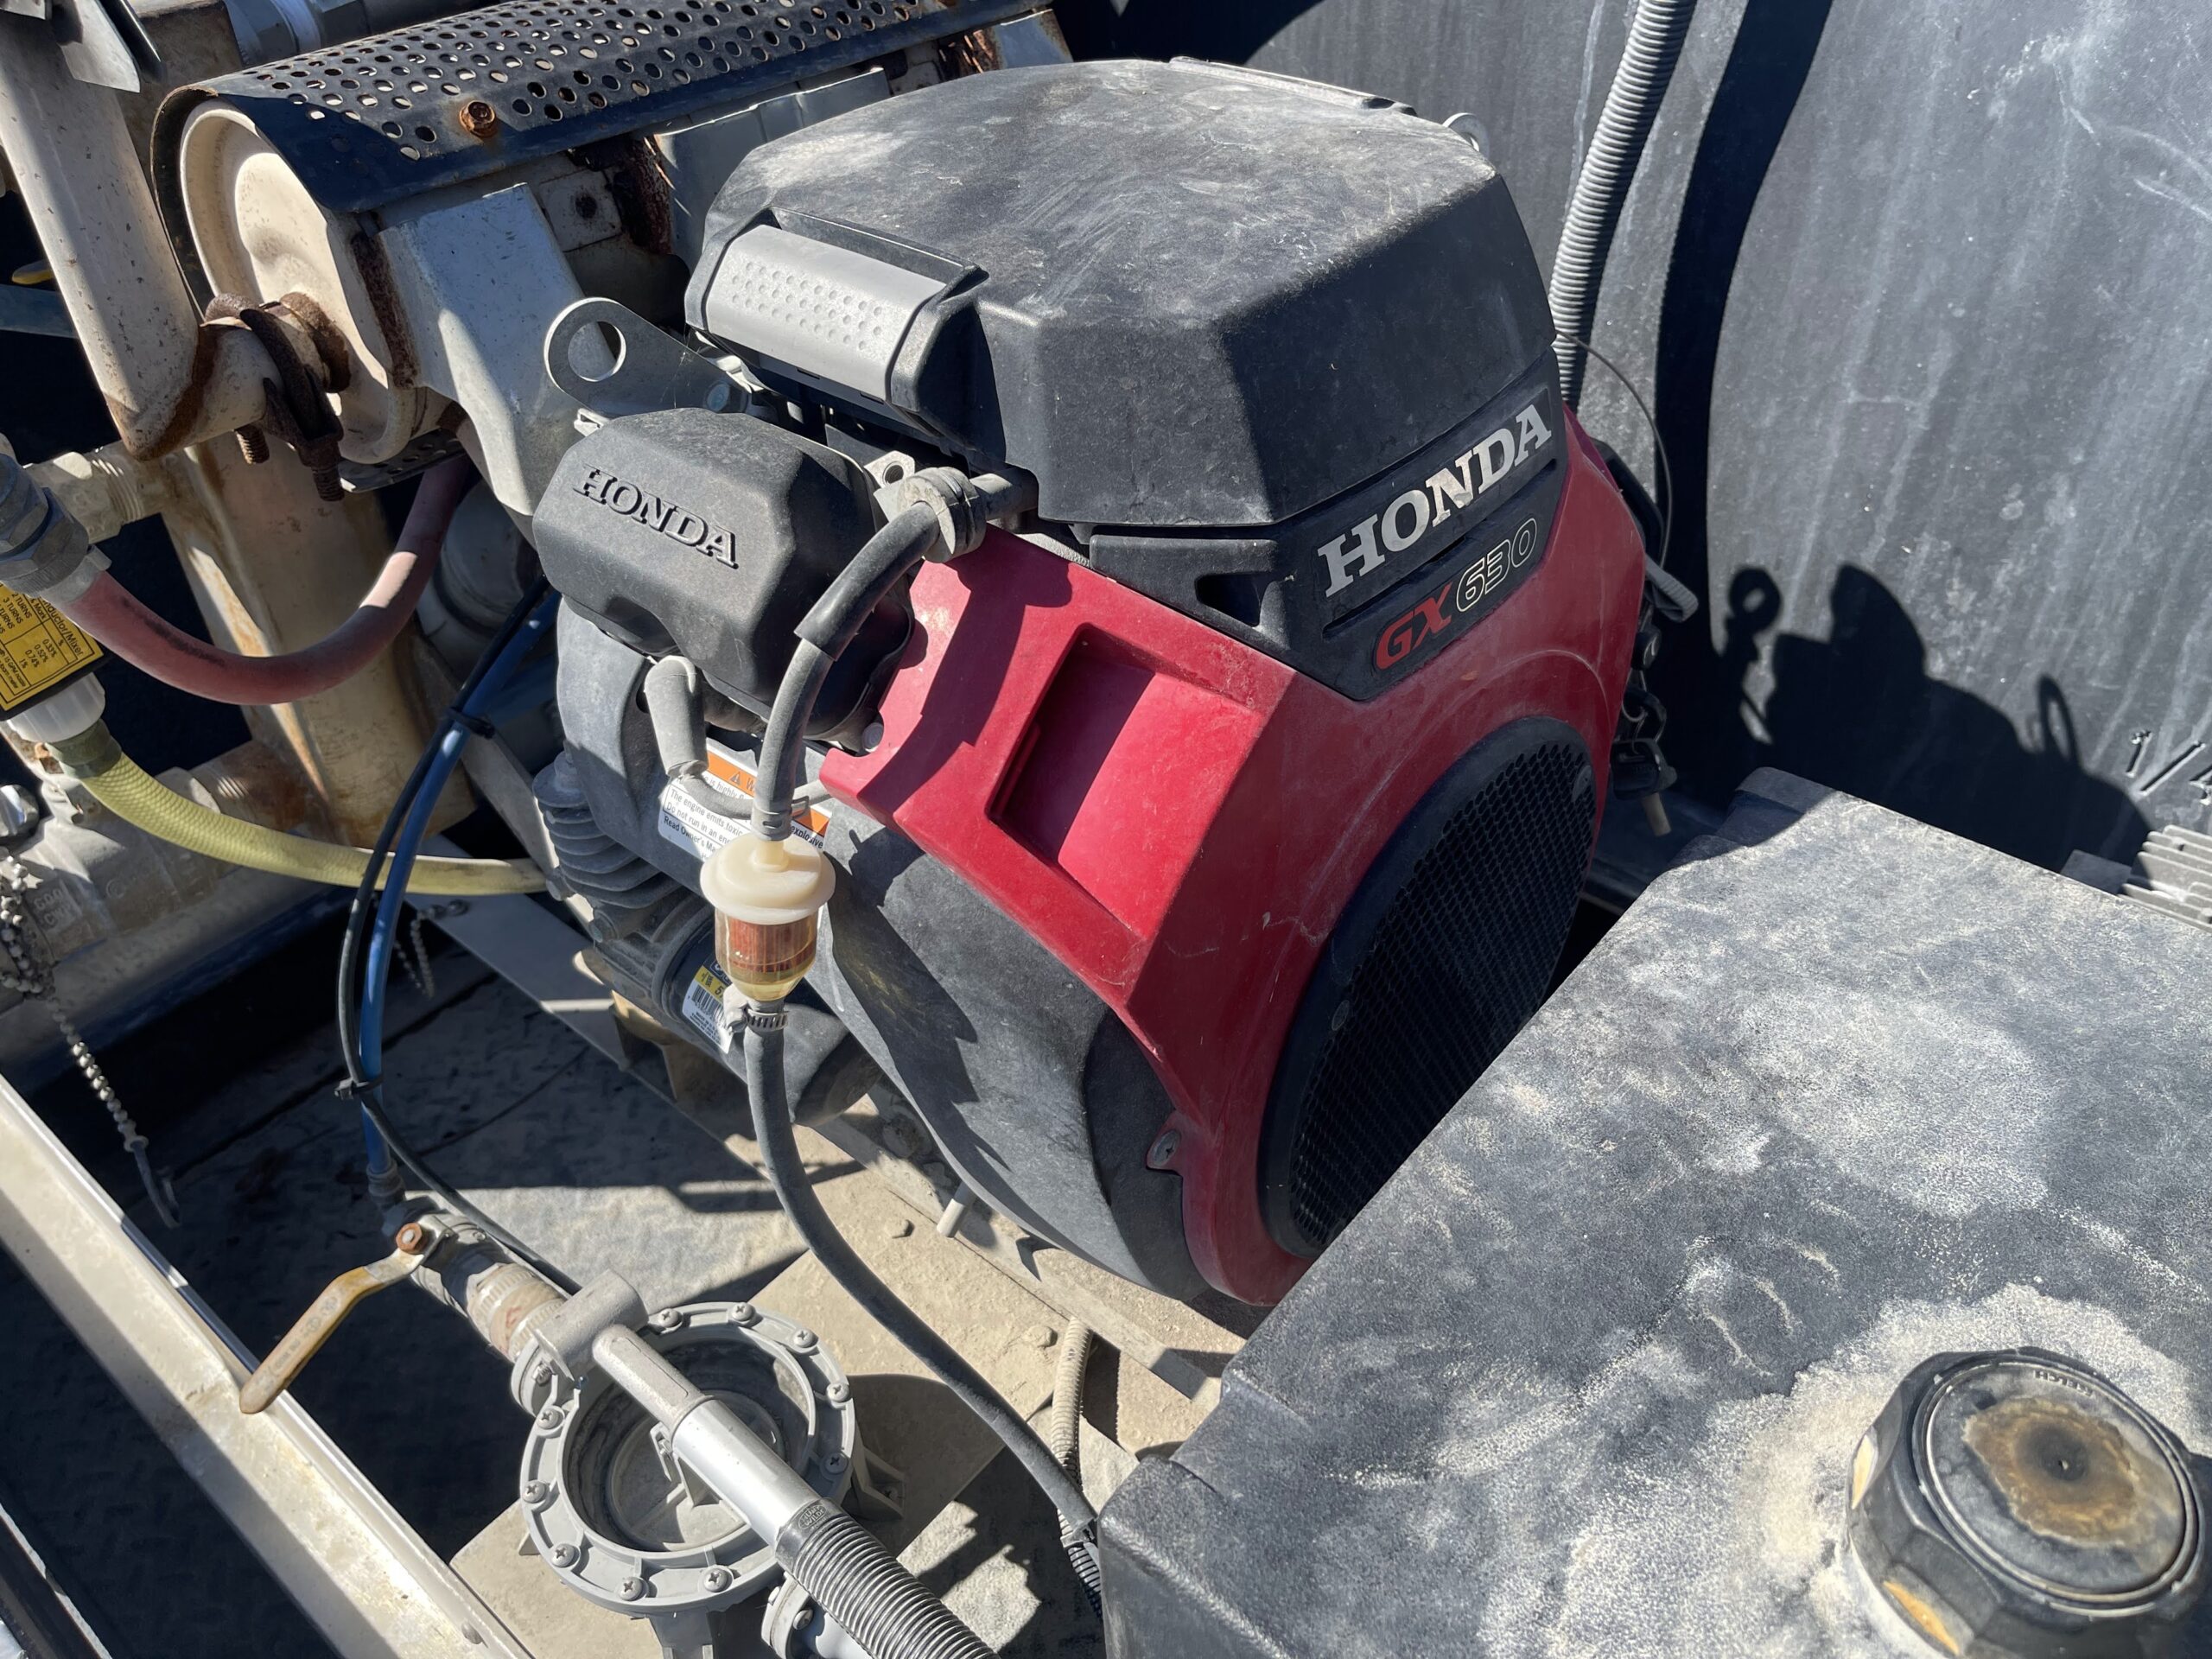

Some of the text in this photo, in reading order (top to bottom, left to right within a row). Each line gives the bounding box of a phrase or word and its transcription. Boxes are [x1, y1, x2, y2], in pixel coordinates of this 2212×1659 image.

[1318, 404, 1551, 597] HONDA
[572, 463, 740, 570] HONDA
[7, 602, 24, 624] TURNS
[16, 596, 33, 619] TURNS
[33, 603, 47, 620] Mark
[42, 599, 84, 655] nductor/Mixer
[24, 649, 40, 668] 0.74%
[34, 644, 48, 663] 0.52%
[42, 639, 57, 658] 0.33%
[19, 658, 29, 669] 1%
[670, 788, 683, 803] The
[683, 797, 706, 817] engine
[706, 808, 725, 827] emits
[664, 815, 680, 832] Read
[680, 825, 706, 849] Owner's
[666, 802, 718, 838] Do not run in an
[790, 823, 824, 849] explosive
